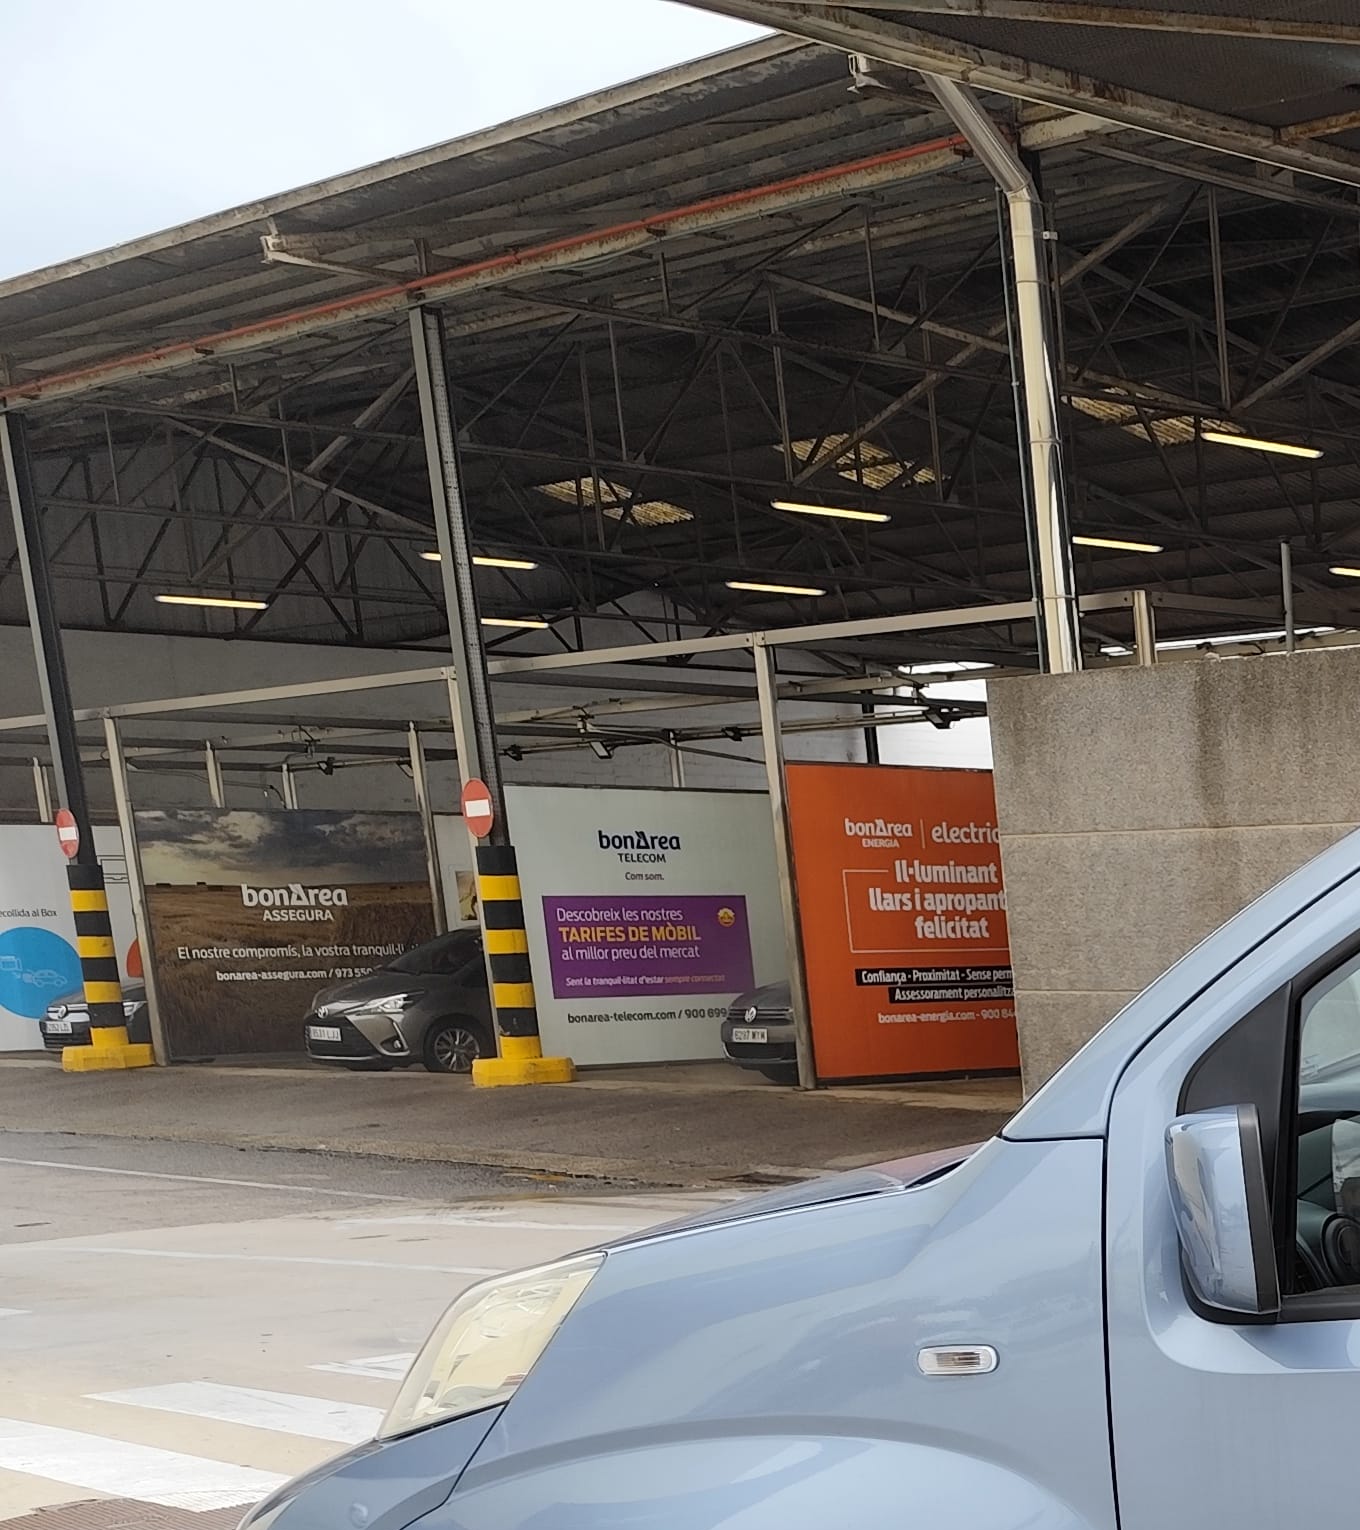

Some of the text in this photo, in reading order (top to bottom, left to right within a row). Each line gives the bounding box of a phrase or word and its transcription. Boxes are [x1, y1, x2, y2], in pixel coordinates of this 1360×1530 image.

[931, 822, 1000, 843] electric
[618, 853, 667, 863] TELECOM
[625, 872, 665, 881] Com som.
[868, 887, 912, 911] llars
[914, 888, 922, 911] i
[263, 909, 335, 922] ASSEGURA
[557, 907, 683, 921] Descobreix les nostres
[558, 922, 702, 942] TARIFES DE MÒBIL
[914, 915, 989, 939] felicitat
[177, 946, 191, 959] El
[192, 946, 230, 958] nostre
[232, 945, 301, 959] compromís,
[302, 945, 314, 957] la
[315, 945, 351, 957] vostra
[561, 945, 701, 961] al millor preu del mercat
[335, 967, 353, 978] 973
[862, 970, 907, 985] Confiança
[912, 968, 961, 982] Proximitat
[966, 968, 991, 981] Sense
[566, 977, 583, 987] Sent
[584, 976, 593, 985] la
[895, 987, 963, 1001] Assessorament
[567, 1010, 677, 1023] bonarea-telecom.com
[684, 1008, 706, 1018] 900
[707, 1007, 728, 1018] 699
[980, 1009, 1001, 1019] 900
